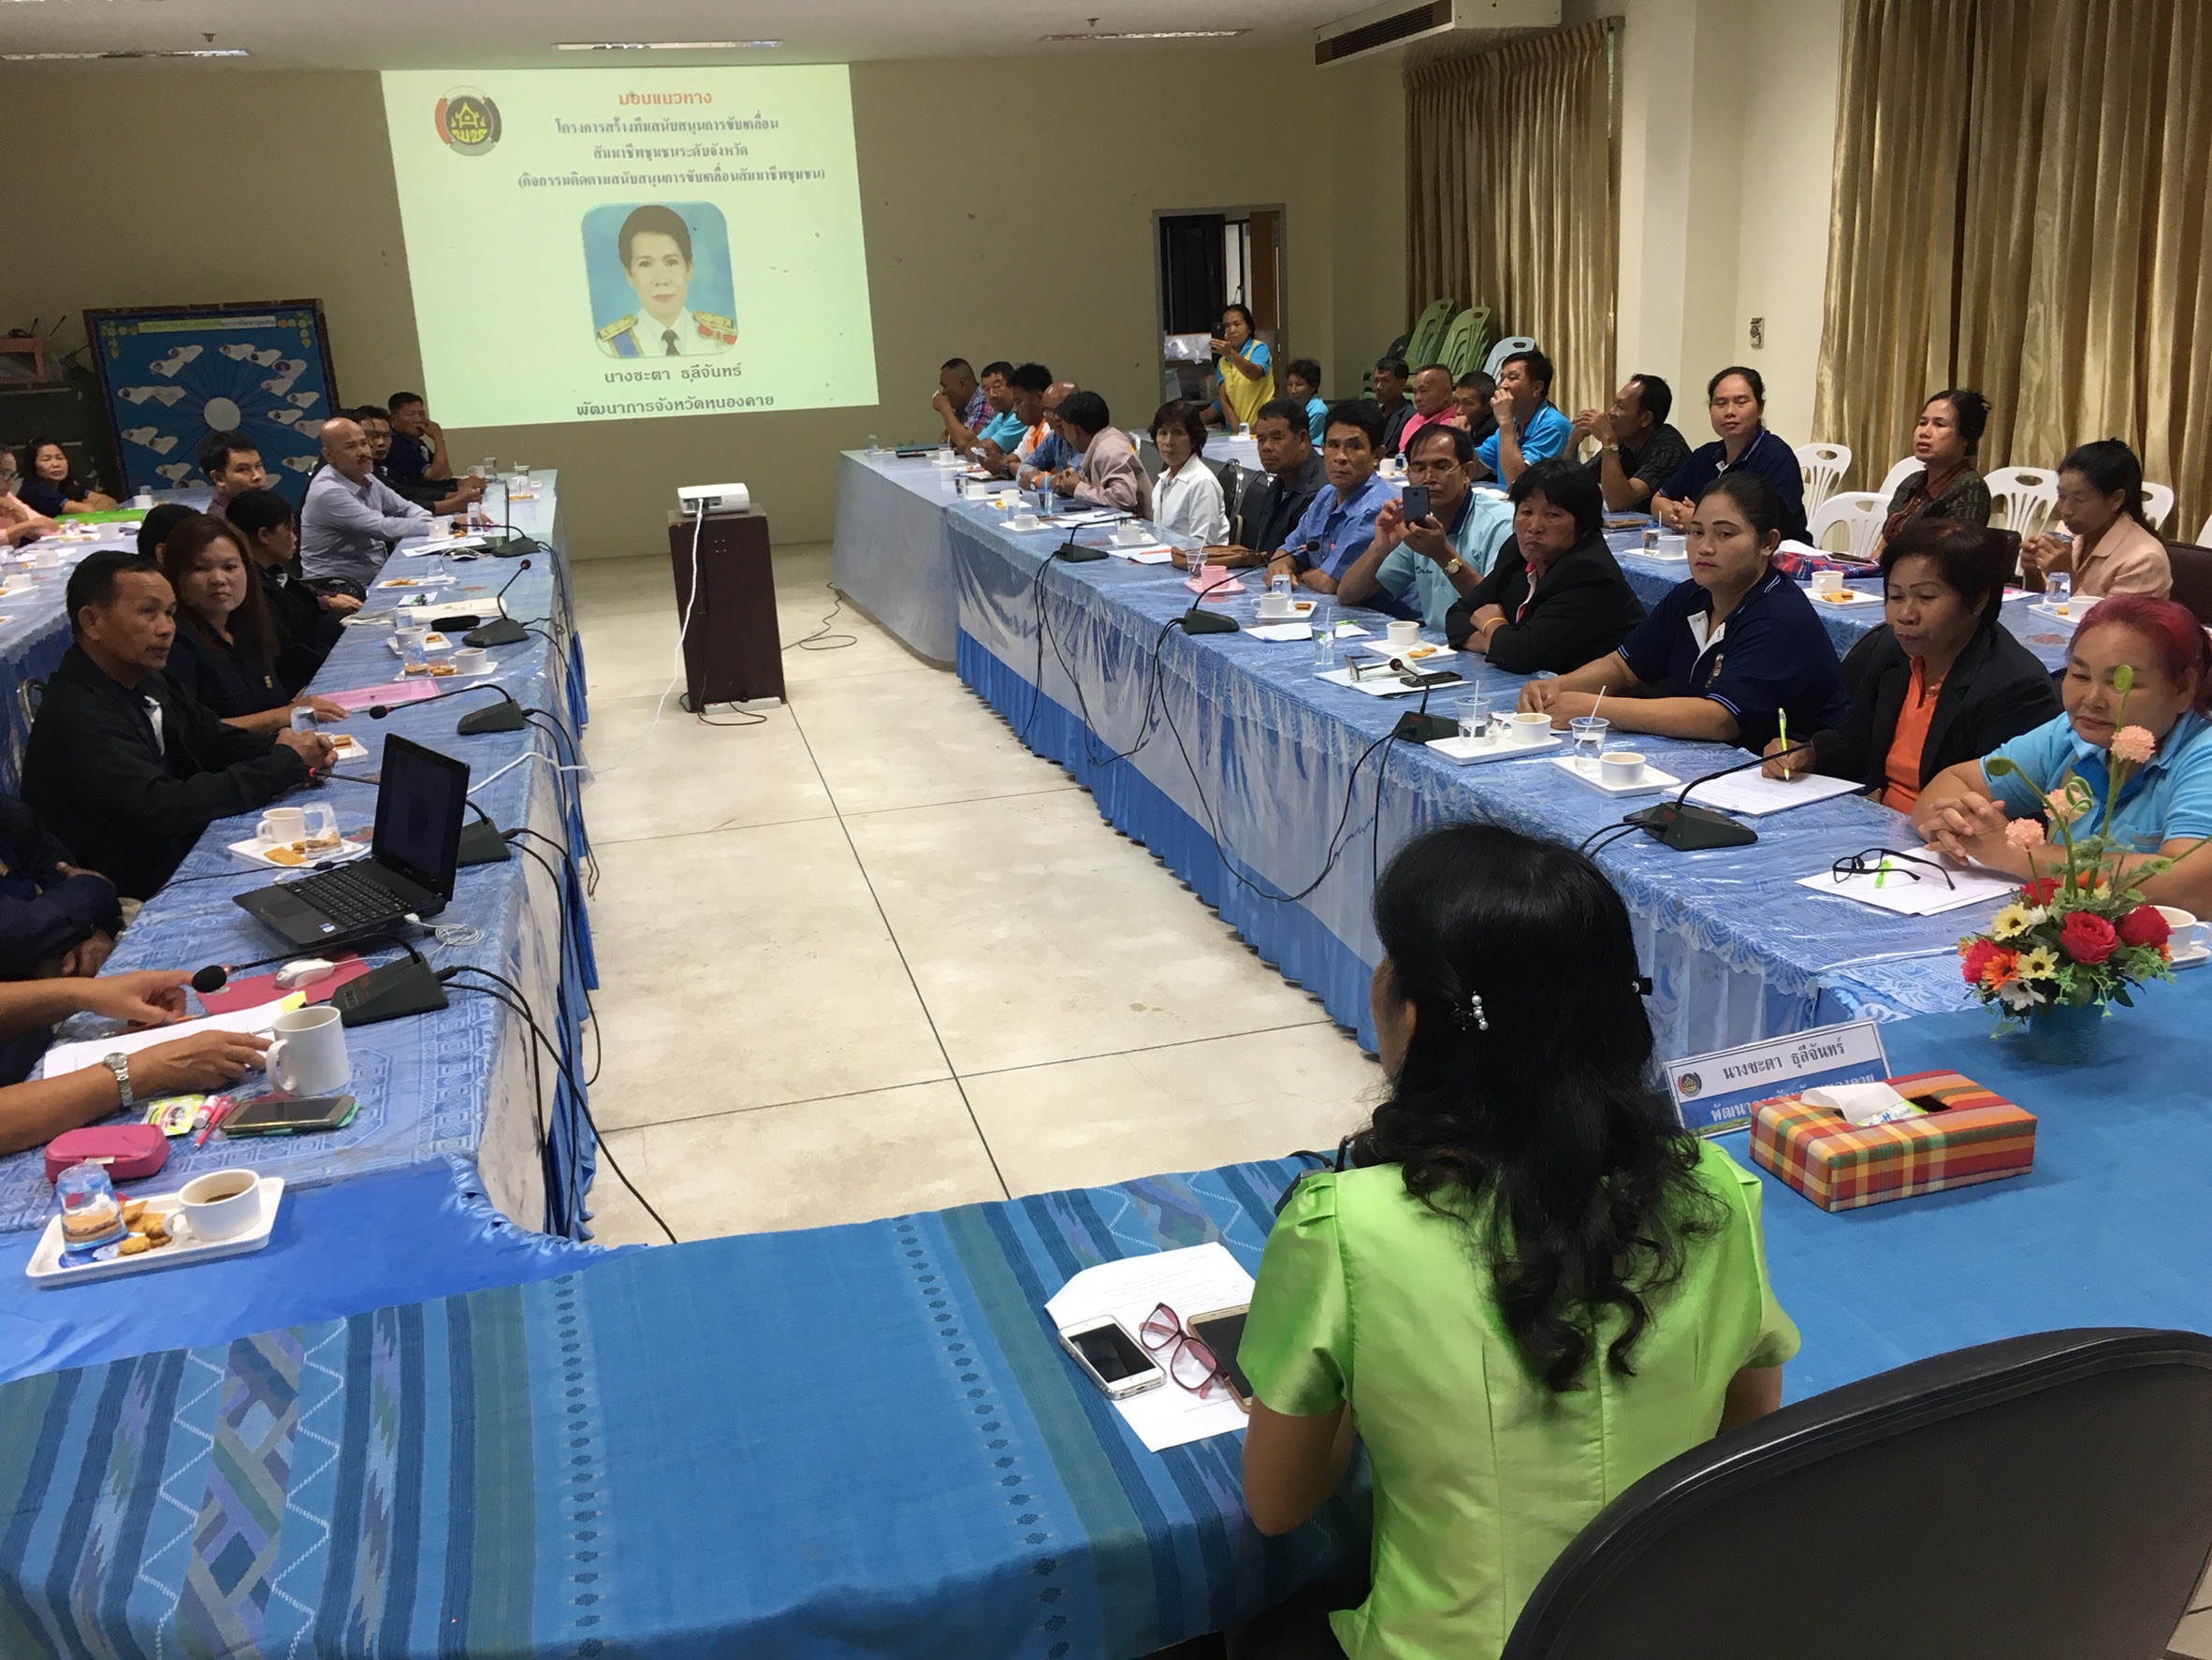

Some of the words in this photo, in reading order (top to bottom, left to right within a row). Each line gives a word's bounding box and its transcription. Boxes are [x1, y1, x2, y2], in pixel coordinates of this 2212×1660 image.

[618, 92, 713, 106] มอบแนวทาง
[555, 109, 779, 135] โครงการสร้างทีมสนับสนุนการขับเคลื่อน
[593, 142, 749, 162] สัมมาชีพชุมชนระดับจังหวัด
[604, 369, 671, 384] นางชะตา
[680, 361, 743, 384] ธุลีจันทร์
[575, 395, 775, 416] พัฒนาการจังหวัดหนองคาย
[1723, 1056, 1783, 1080] นางชะตา
[1790, 1036, 1845, 1070] ธุลีจันทร์
